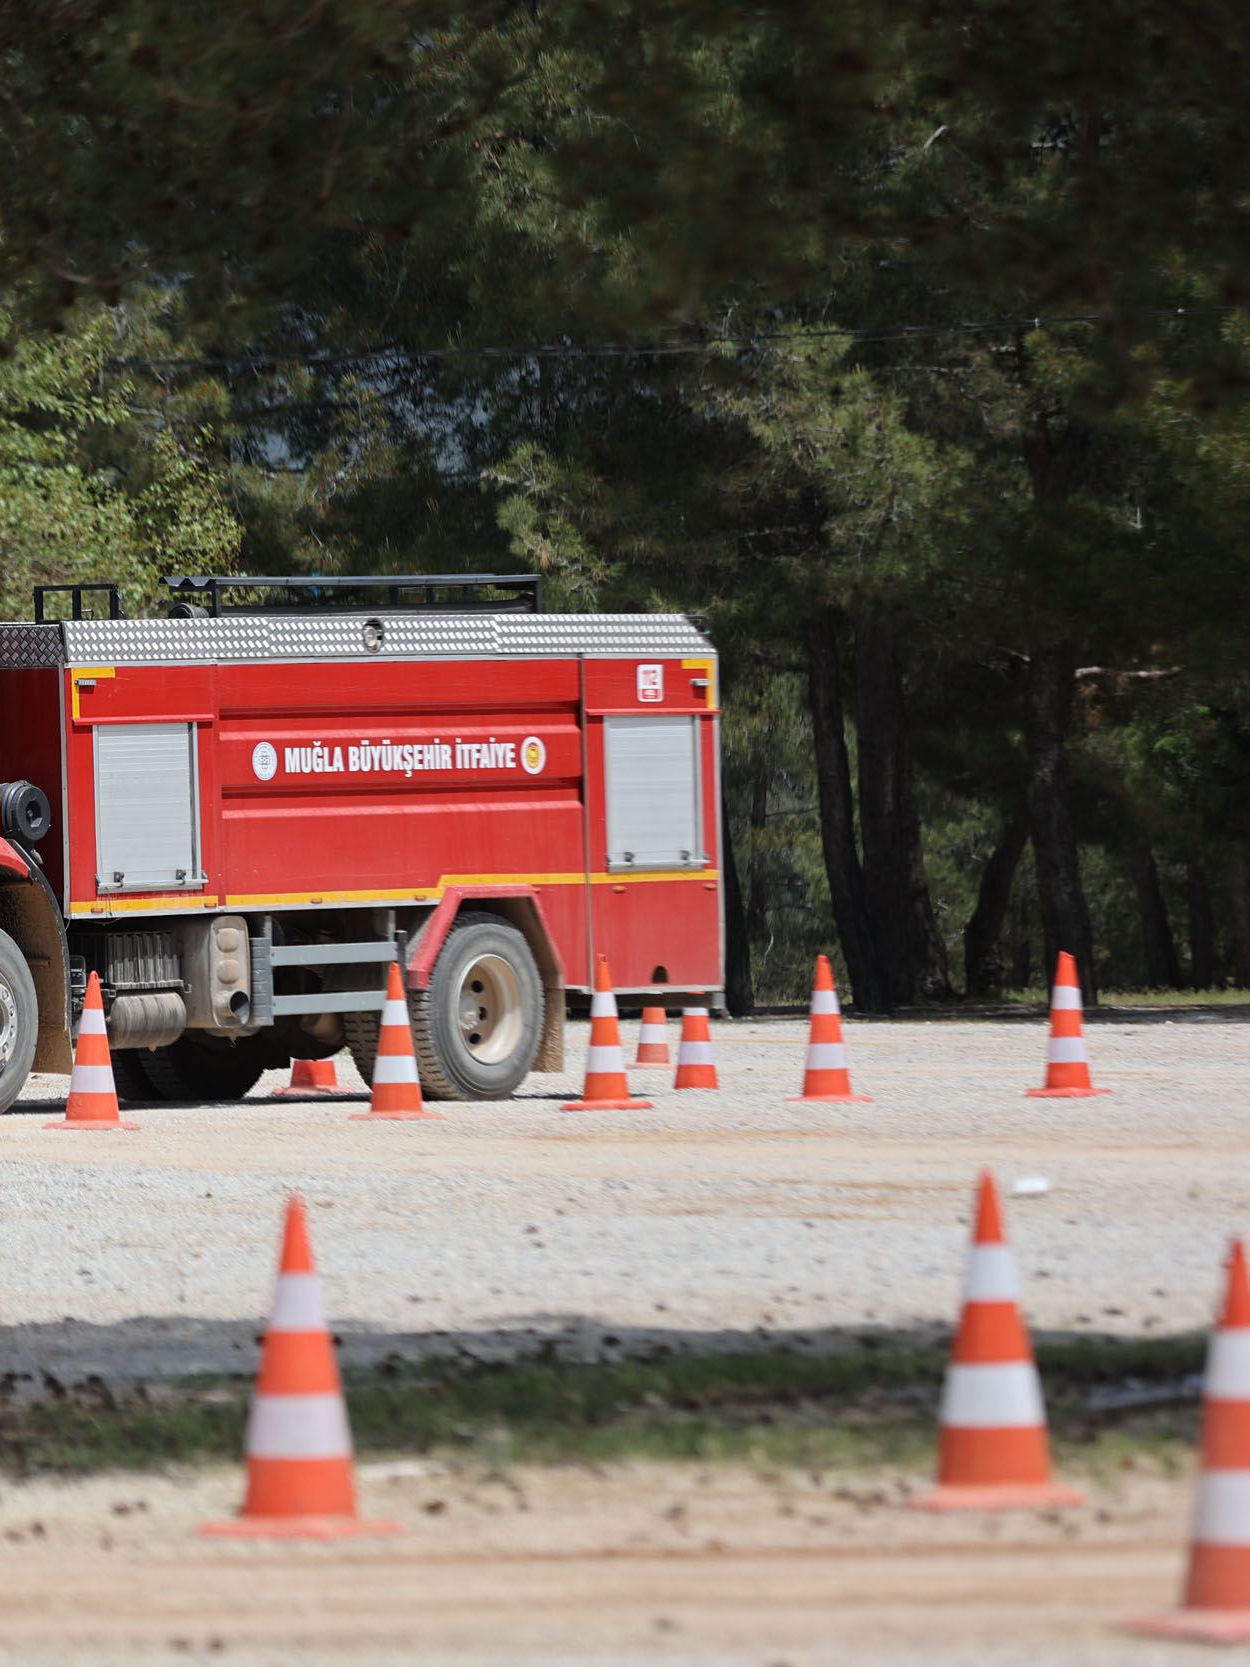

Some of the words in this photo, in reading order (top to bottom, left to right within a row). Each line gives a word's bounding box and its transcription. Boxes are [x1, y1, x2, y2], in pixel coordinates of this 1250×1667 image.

[284, 741, 344, 773] MUĞLA
[350, 738, 452, 777] BÜYÜKŞEHİR
[455, 737, 517, 770] İTFAİYE
